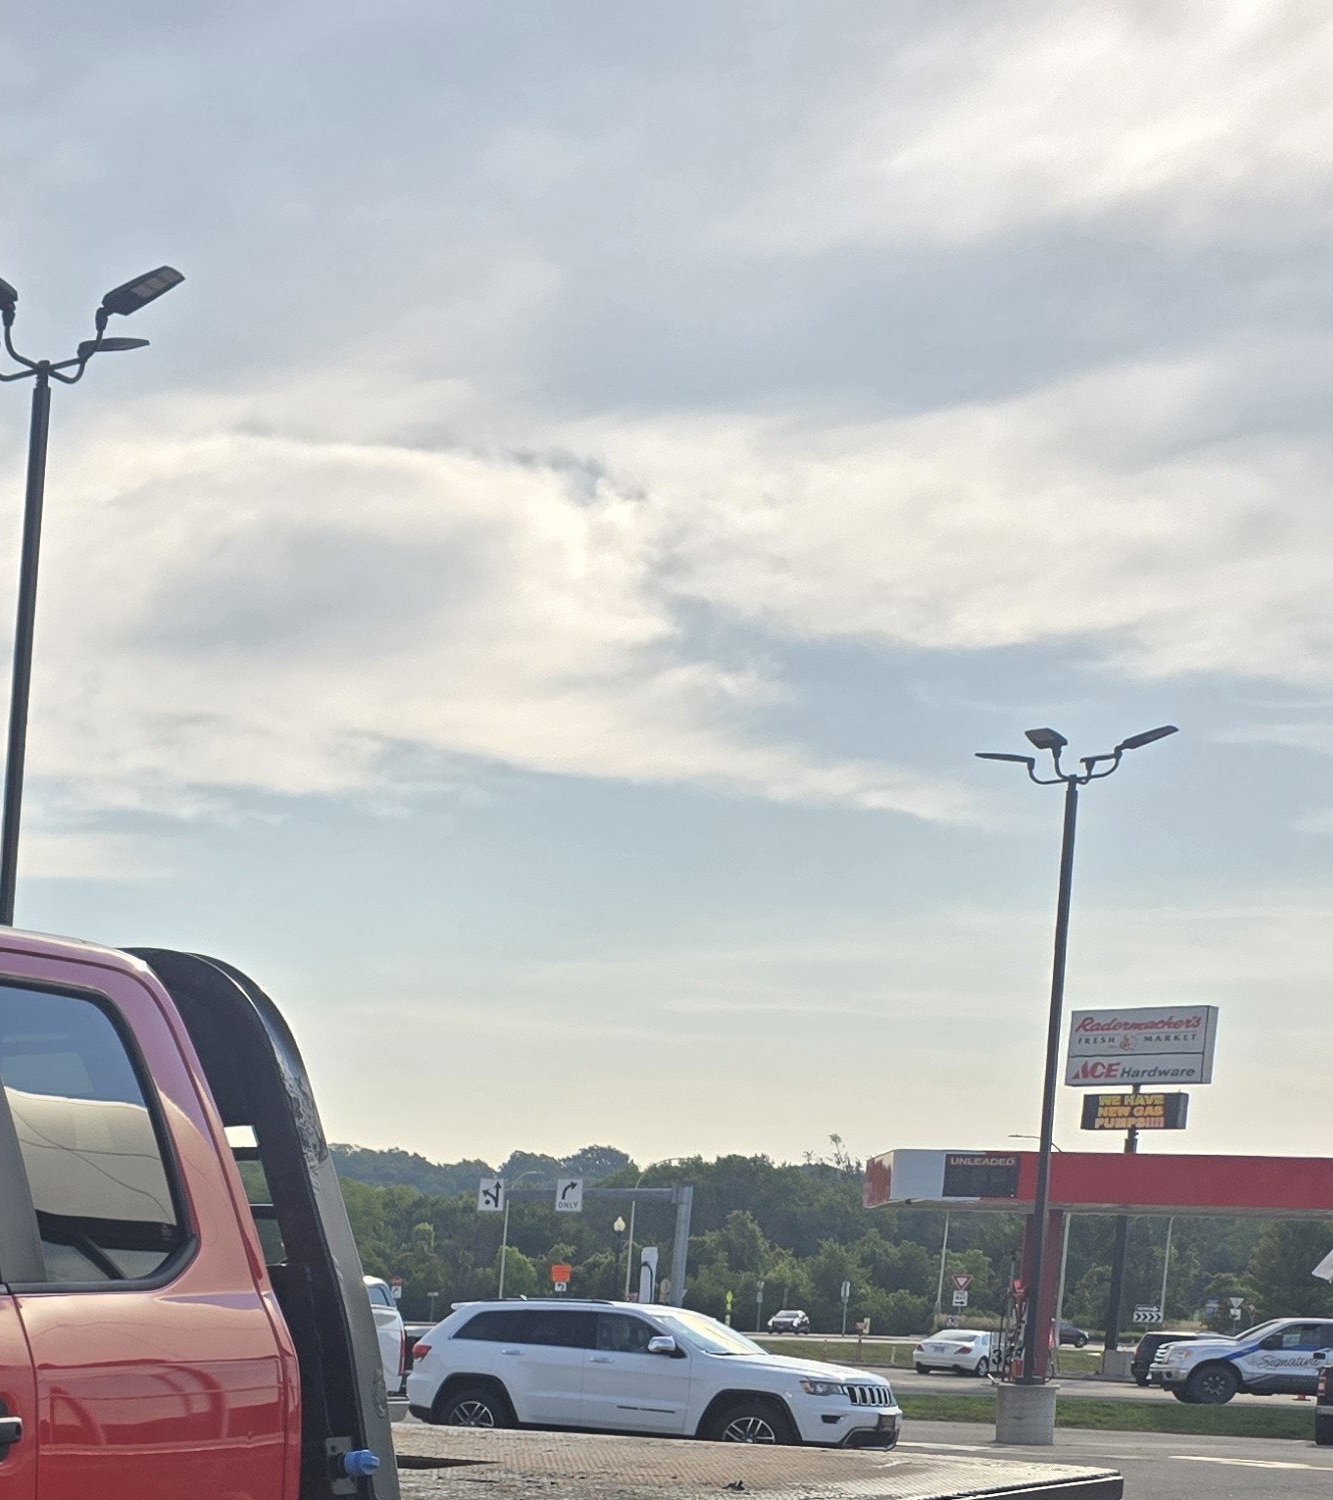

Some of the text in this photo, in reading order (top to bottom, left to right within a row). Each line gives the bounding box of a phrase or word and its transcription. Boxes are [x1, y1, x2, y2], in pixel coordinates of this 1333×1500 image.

[1078, 1034, 1197, 1044] FRESH MARKET
[1071, 1060, 1195, 1080] ACE Hardware
[1099, 1094, 1164, 1106] WE HAVE
[1097, 1106, 1164, 1117] NEW GAS
[950, 1157, 1016, 1166] UNLEADED
[558, 1201, 579, 1209] ONLY
